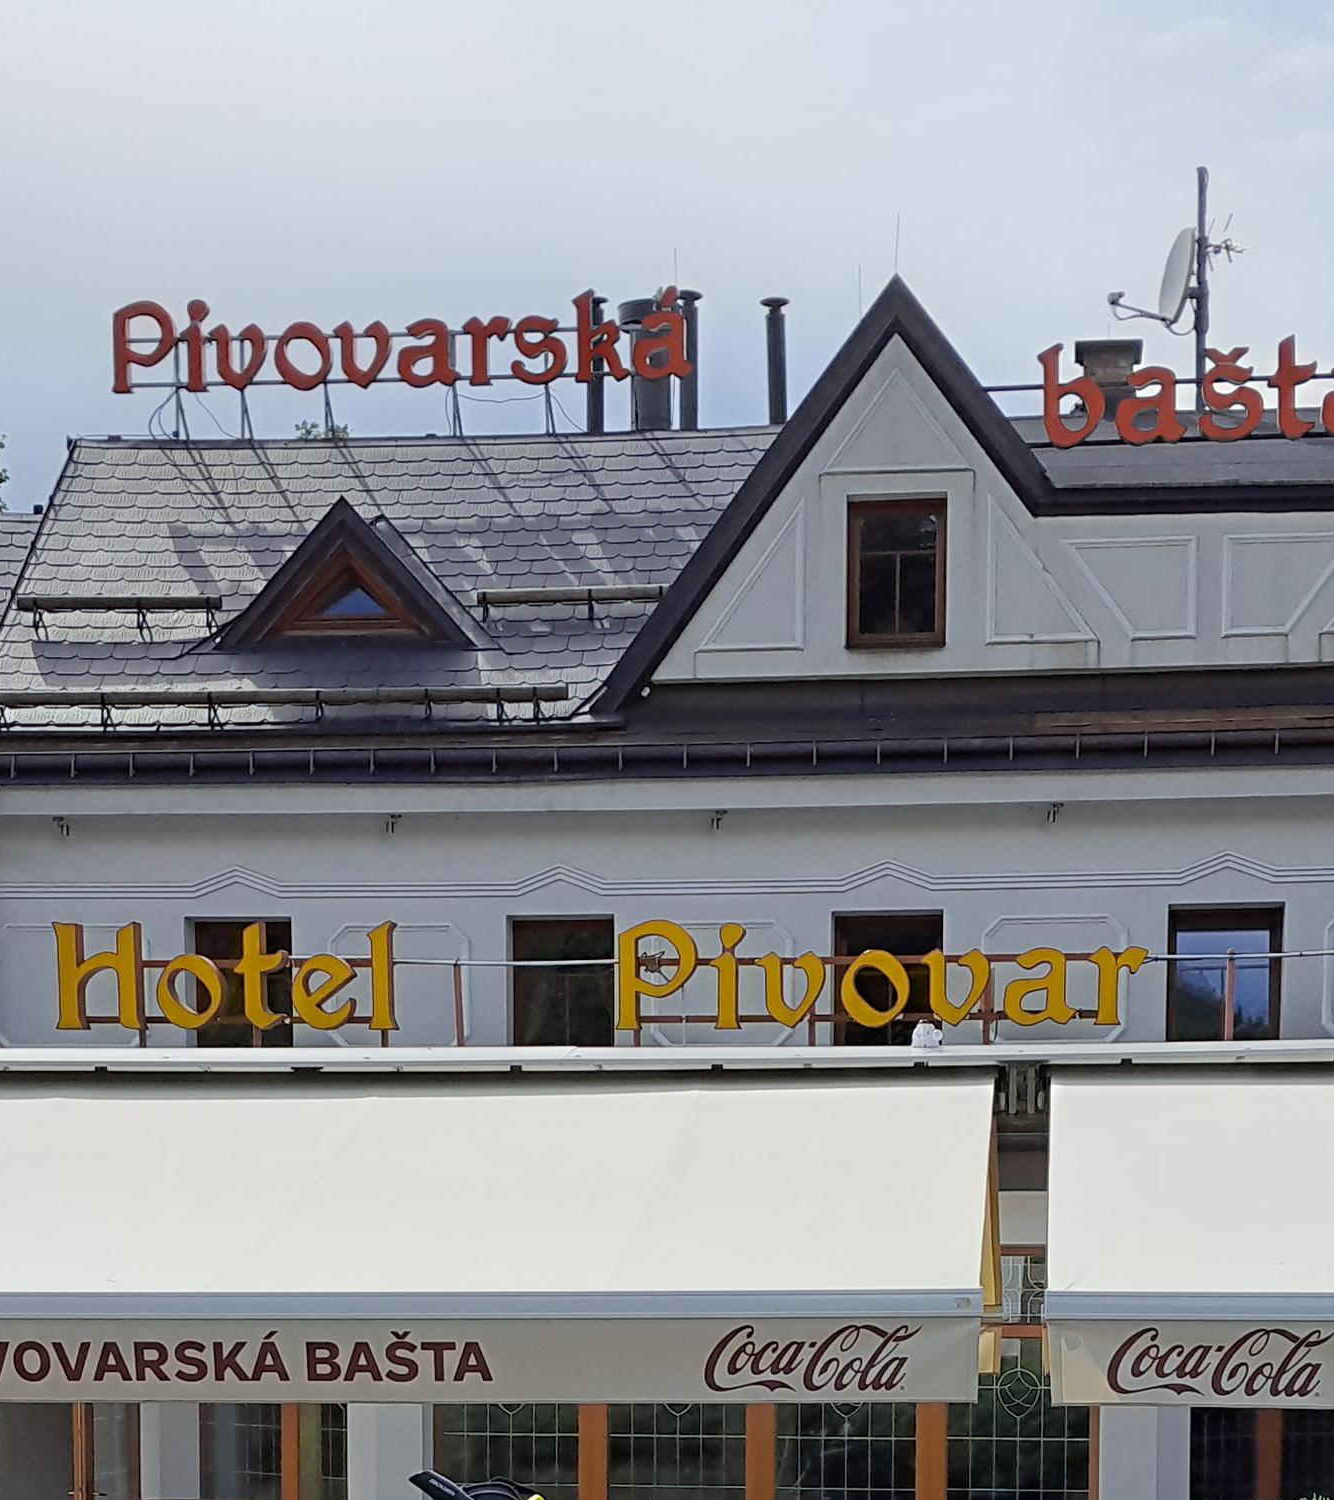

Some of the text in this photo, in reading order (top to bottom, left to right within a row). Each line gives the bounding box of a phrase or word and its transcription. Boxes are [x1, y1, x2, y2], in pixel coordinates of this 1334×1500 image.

[112, 285, 693, 393] Pivovarská
[52, 920, 400, 1031] Hotel
[616, 918, 1149, 1031] Pivovar
[305, 1330, 494, 1383] BAŠTA
[704, 1324, 924, 1393] Coca-Cola
